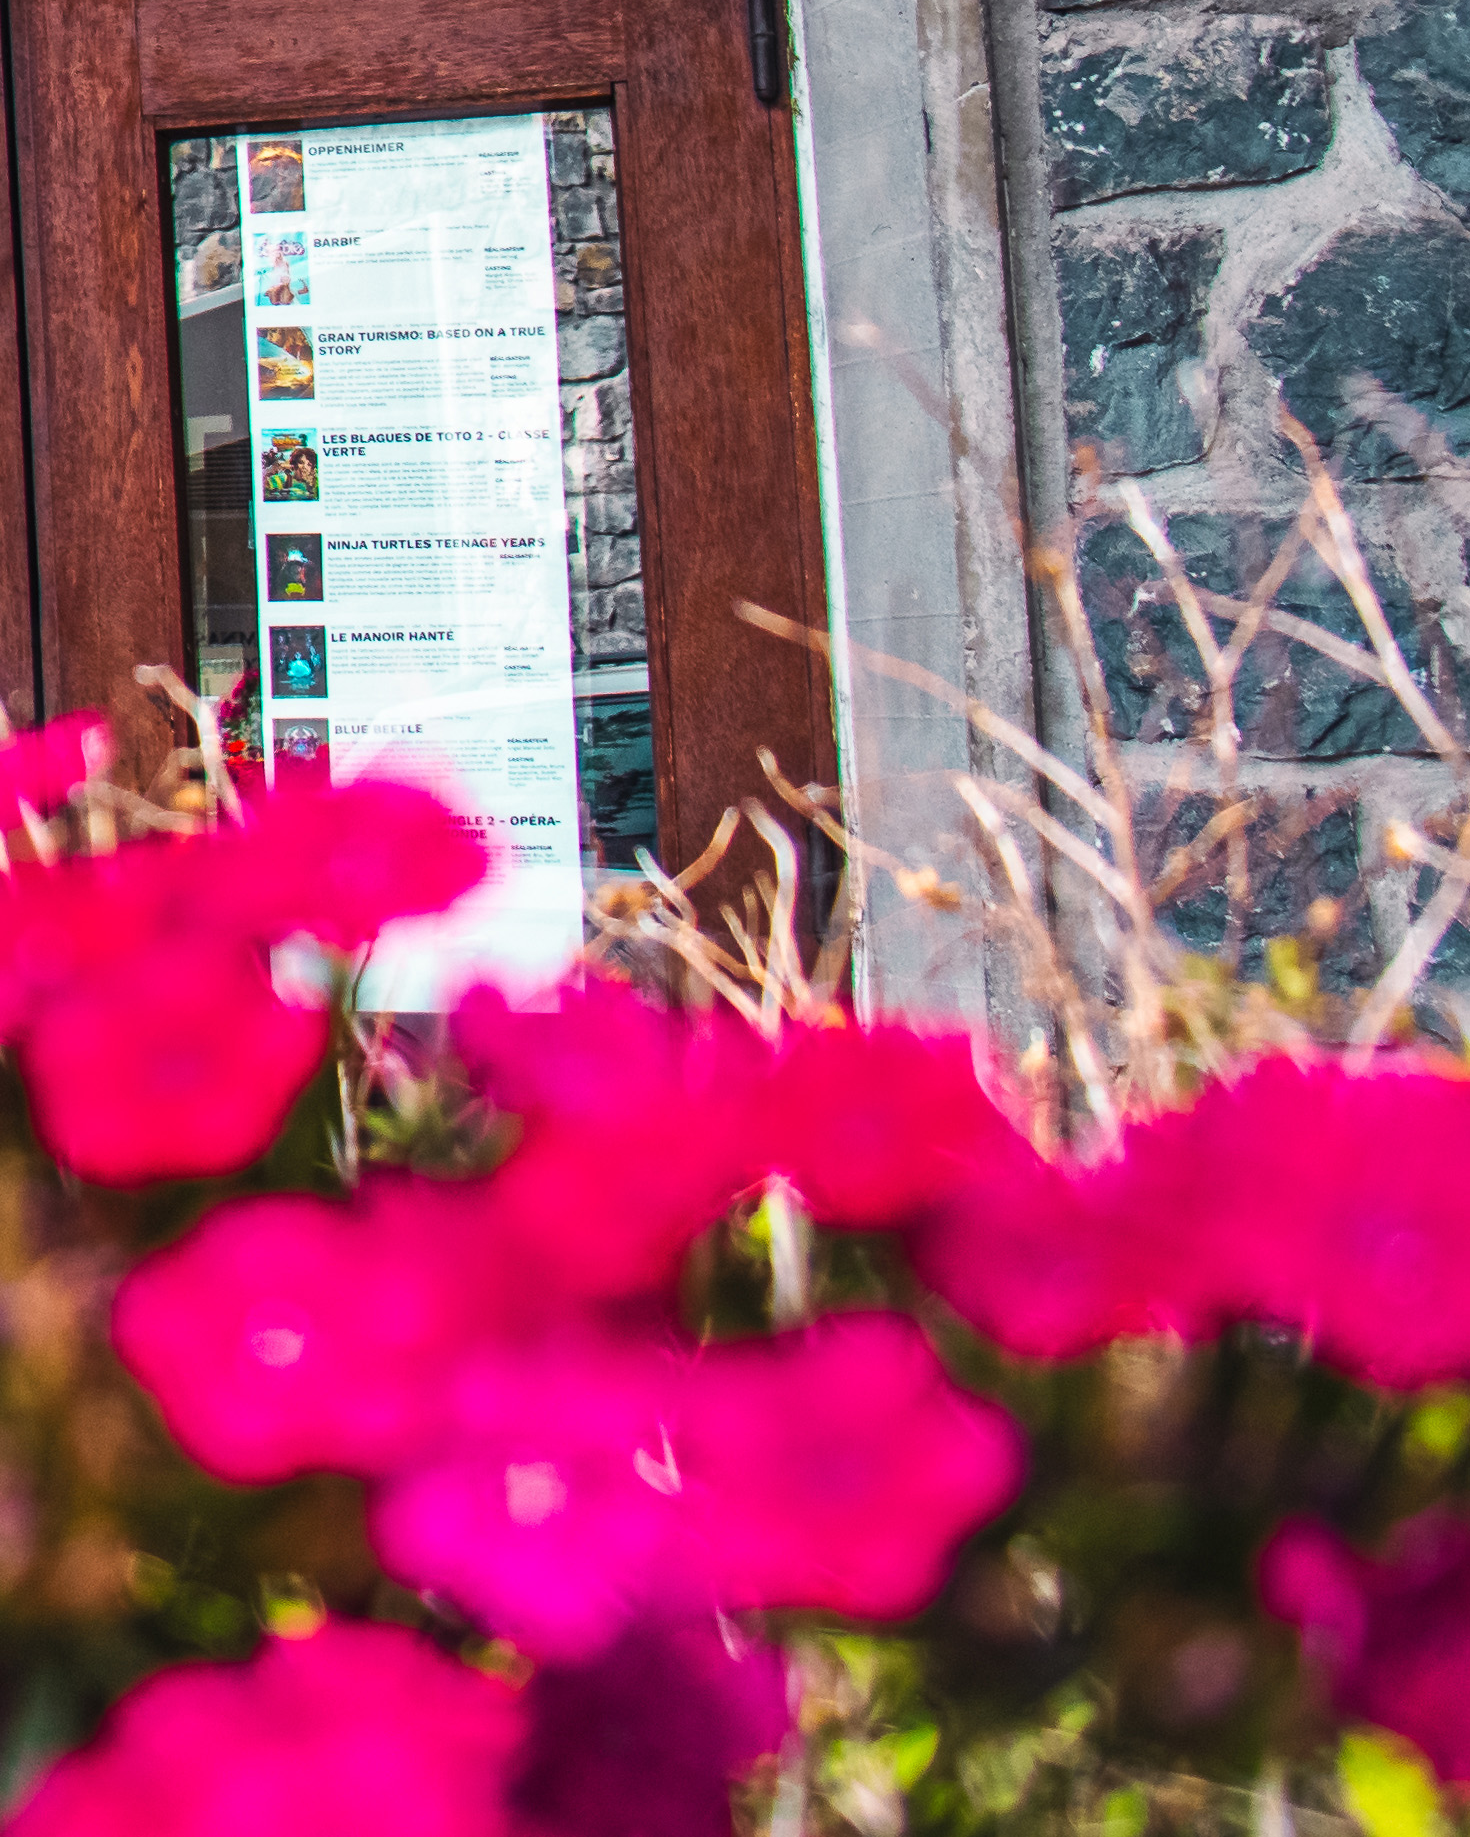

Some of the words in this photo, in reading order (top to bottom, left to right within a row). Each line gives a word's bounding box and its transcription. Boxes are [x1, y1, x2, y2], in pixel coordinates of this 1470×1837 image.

[308, 141, 405, 156] OPPENHEIMER
[313, 236, 362, 248] BARBIE
[318, 331, 355, 344] GRAN
[359, 330, 423, 342] TURISMO:
[427, 328, 471, 341] BASED
[474, 327, 495, 338] ON
[497, 327, 507, 337] A
[509, 325, 546, 336] TRUE
[318, 344, 362, 356] STORY
[322, 433, 347, 444] LES
[350, 432, 411, 444] BLAGUES
[415, 431, 433, 442] DE
[436, 431, 472, 442] TOTO
[475, 431, 484, 441] 2
[322, 446, 366, 457] VERTE
[328, 539, 368, 551] NINJA
[371, 539, 432, 550] TURTLES
[435, 537, 498, 549] TEENAGE
[500, 536, 546, 548] YEARS
[330, 631, 347, 643] LE
[351, 630, 405, 642] MANOIR
[408, 628, 455, 642] HANTÉ
[334, 723, 369, 735] BLUE
[373, 722, 424, 734] BEETLE
[487, 816, 495, 826] 2
[510, 813, 562, 826] OPÉRA-
